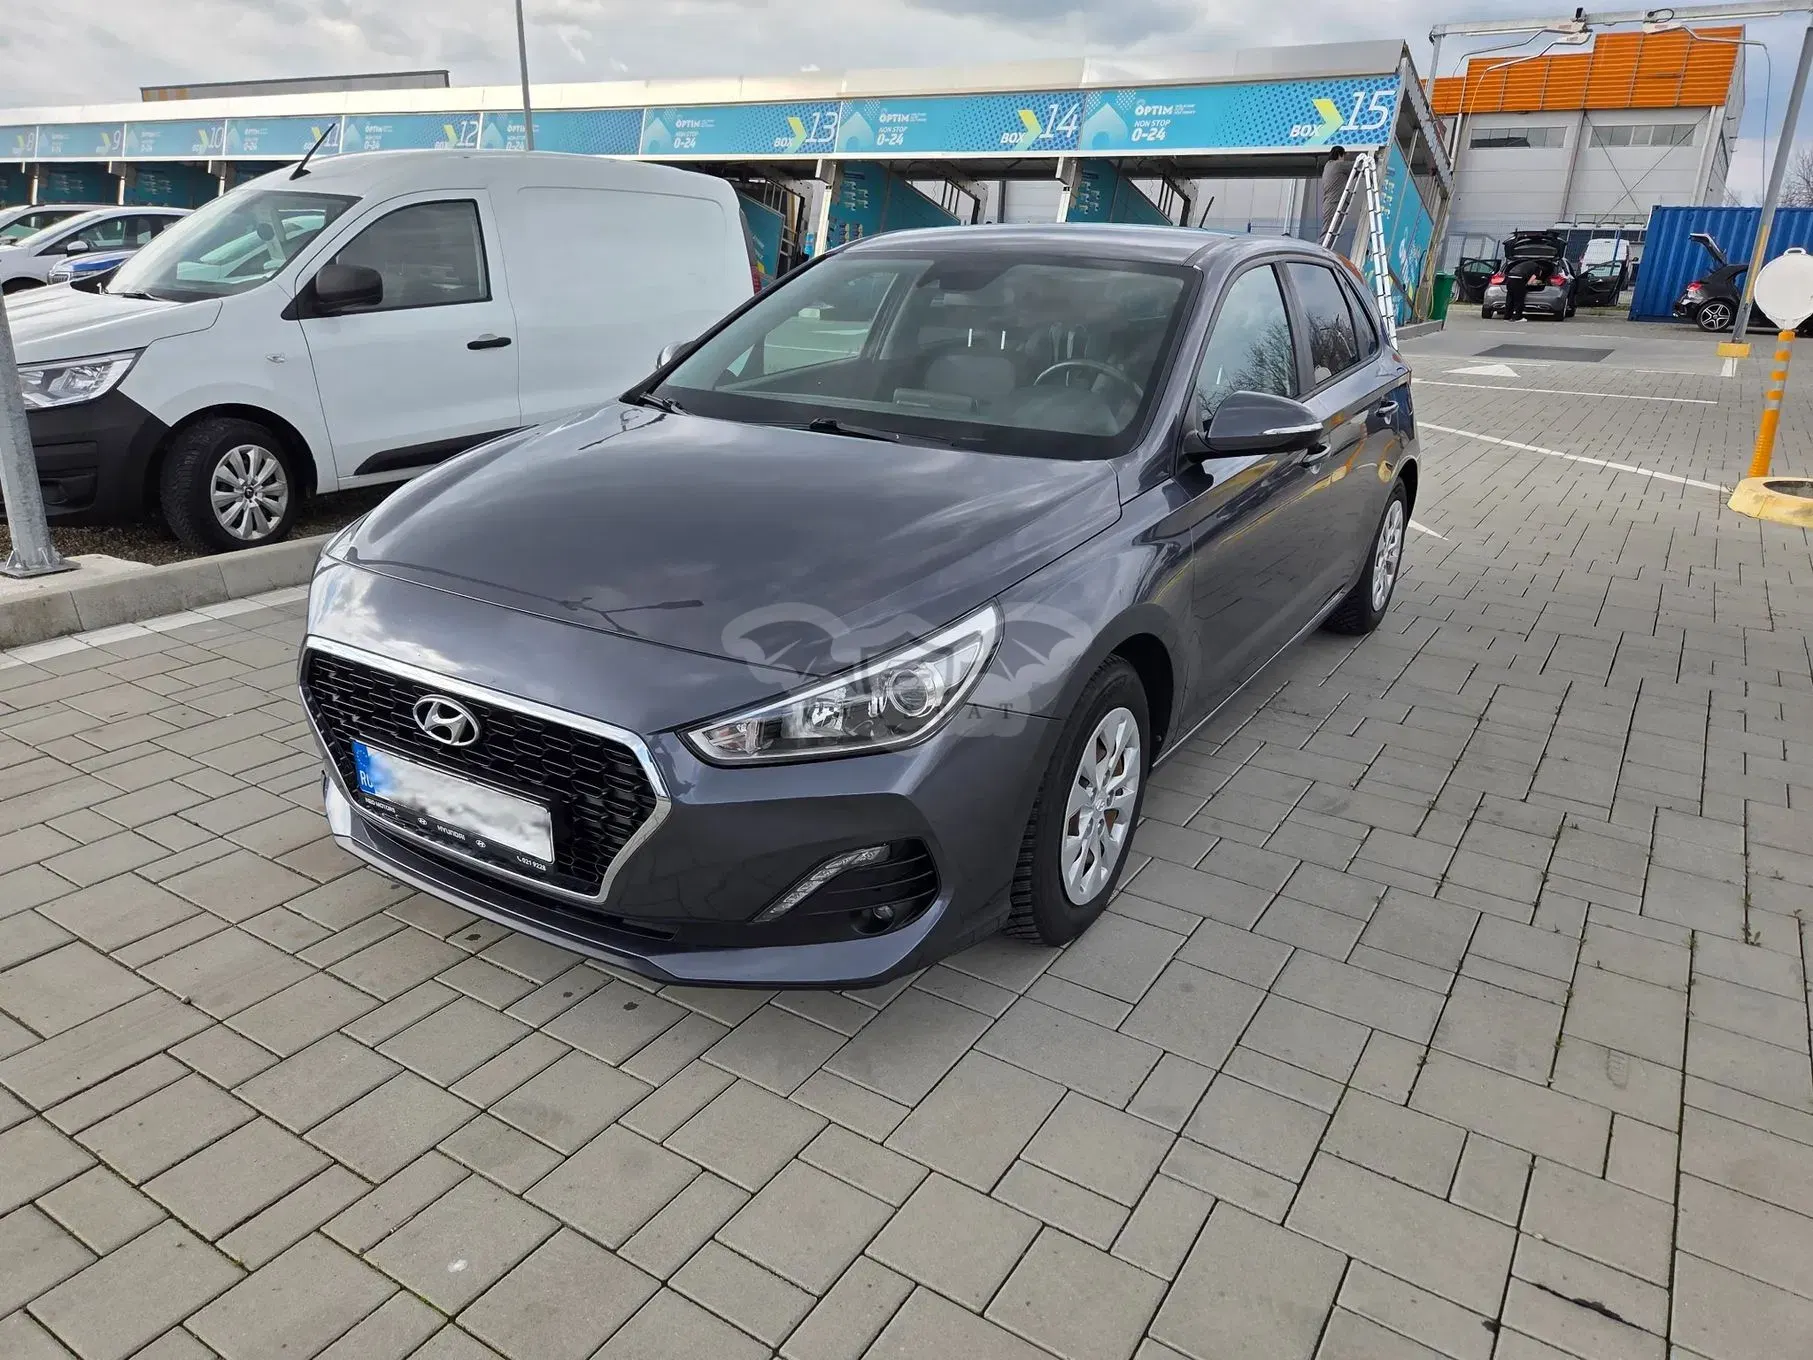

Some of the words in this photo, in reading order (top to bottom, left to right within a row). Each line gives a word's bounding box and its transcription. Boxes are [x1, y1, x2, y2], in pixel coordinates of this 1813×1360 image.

[1134, 104, 1173, 116] OPTIM
[1339, 90, 1396, 131] 15
[878, 112, 910, 123] OPTIM
[1039, 103, 1080, 139] 14
[1134, 120, 1150, 128] NON
[1151, 119, 1171, 128] STOP
[456, 120, 479, 147] 12
[805, 112, 837, 143] 13
[1131, 127, 1167, 142] 0-24
[1289, 125, 1324, 138] BOX
[112, 130, 121, 151] 9
[208, 127, 225, 149] 10
[673, 136, 697, 149] 0-24
[773, 136, 793, 147] BOX
[876, 133, 904, 146] 0-24
[1000, 131, 1027, 145] BOX
